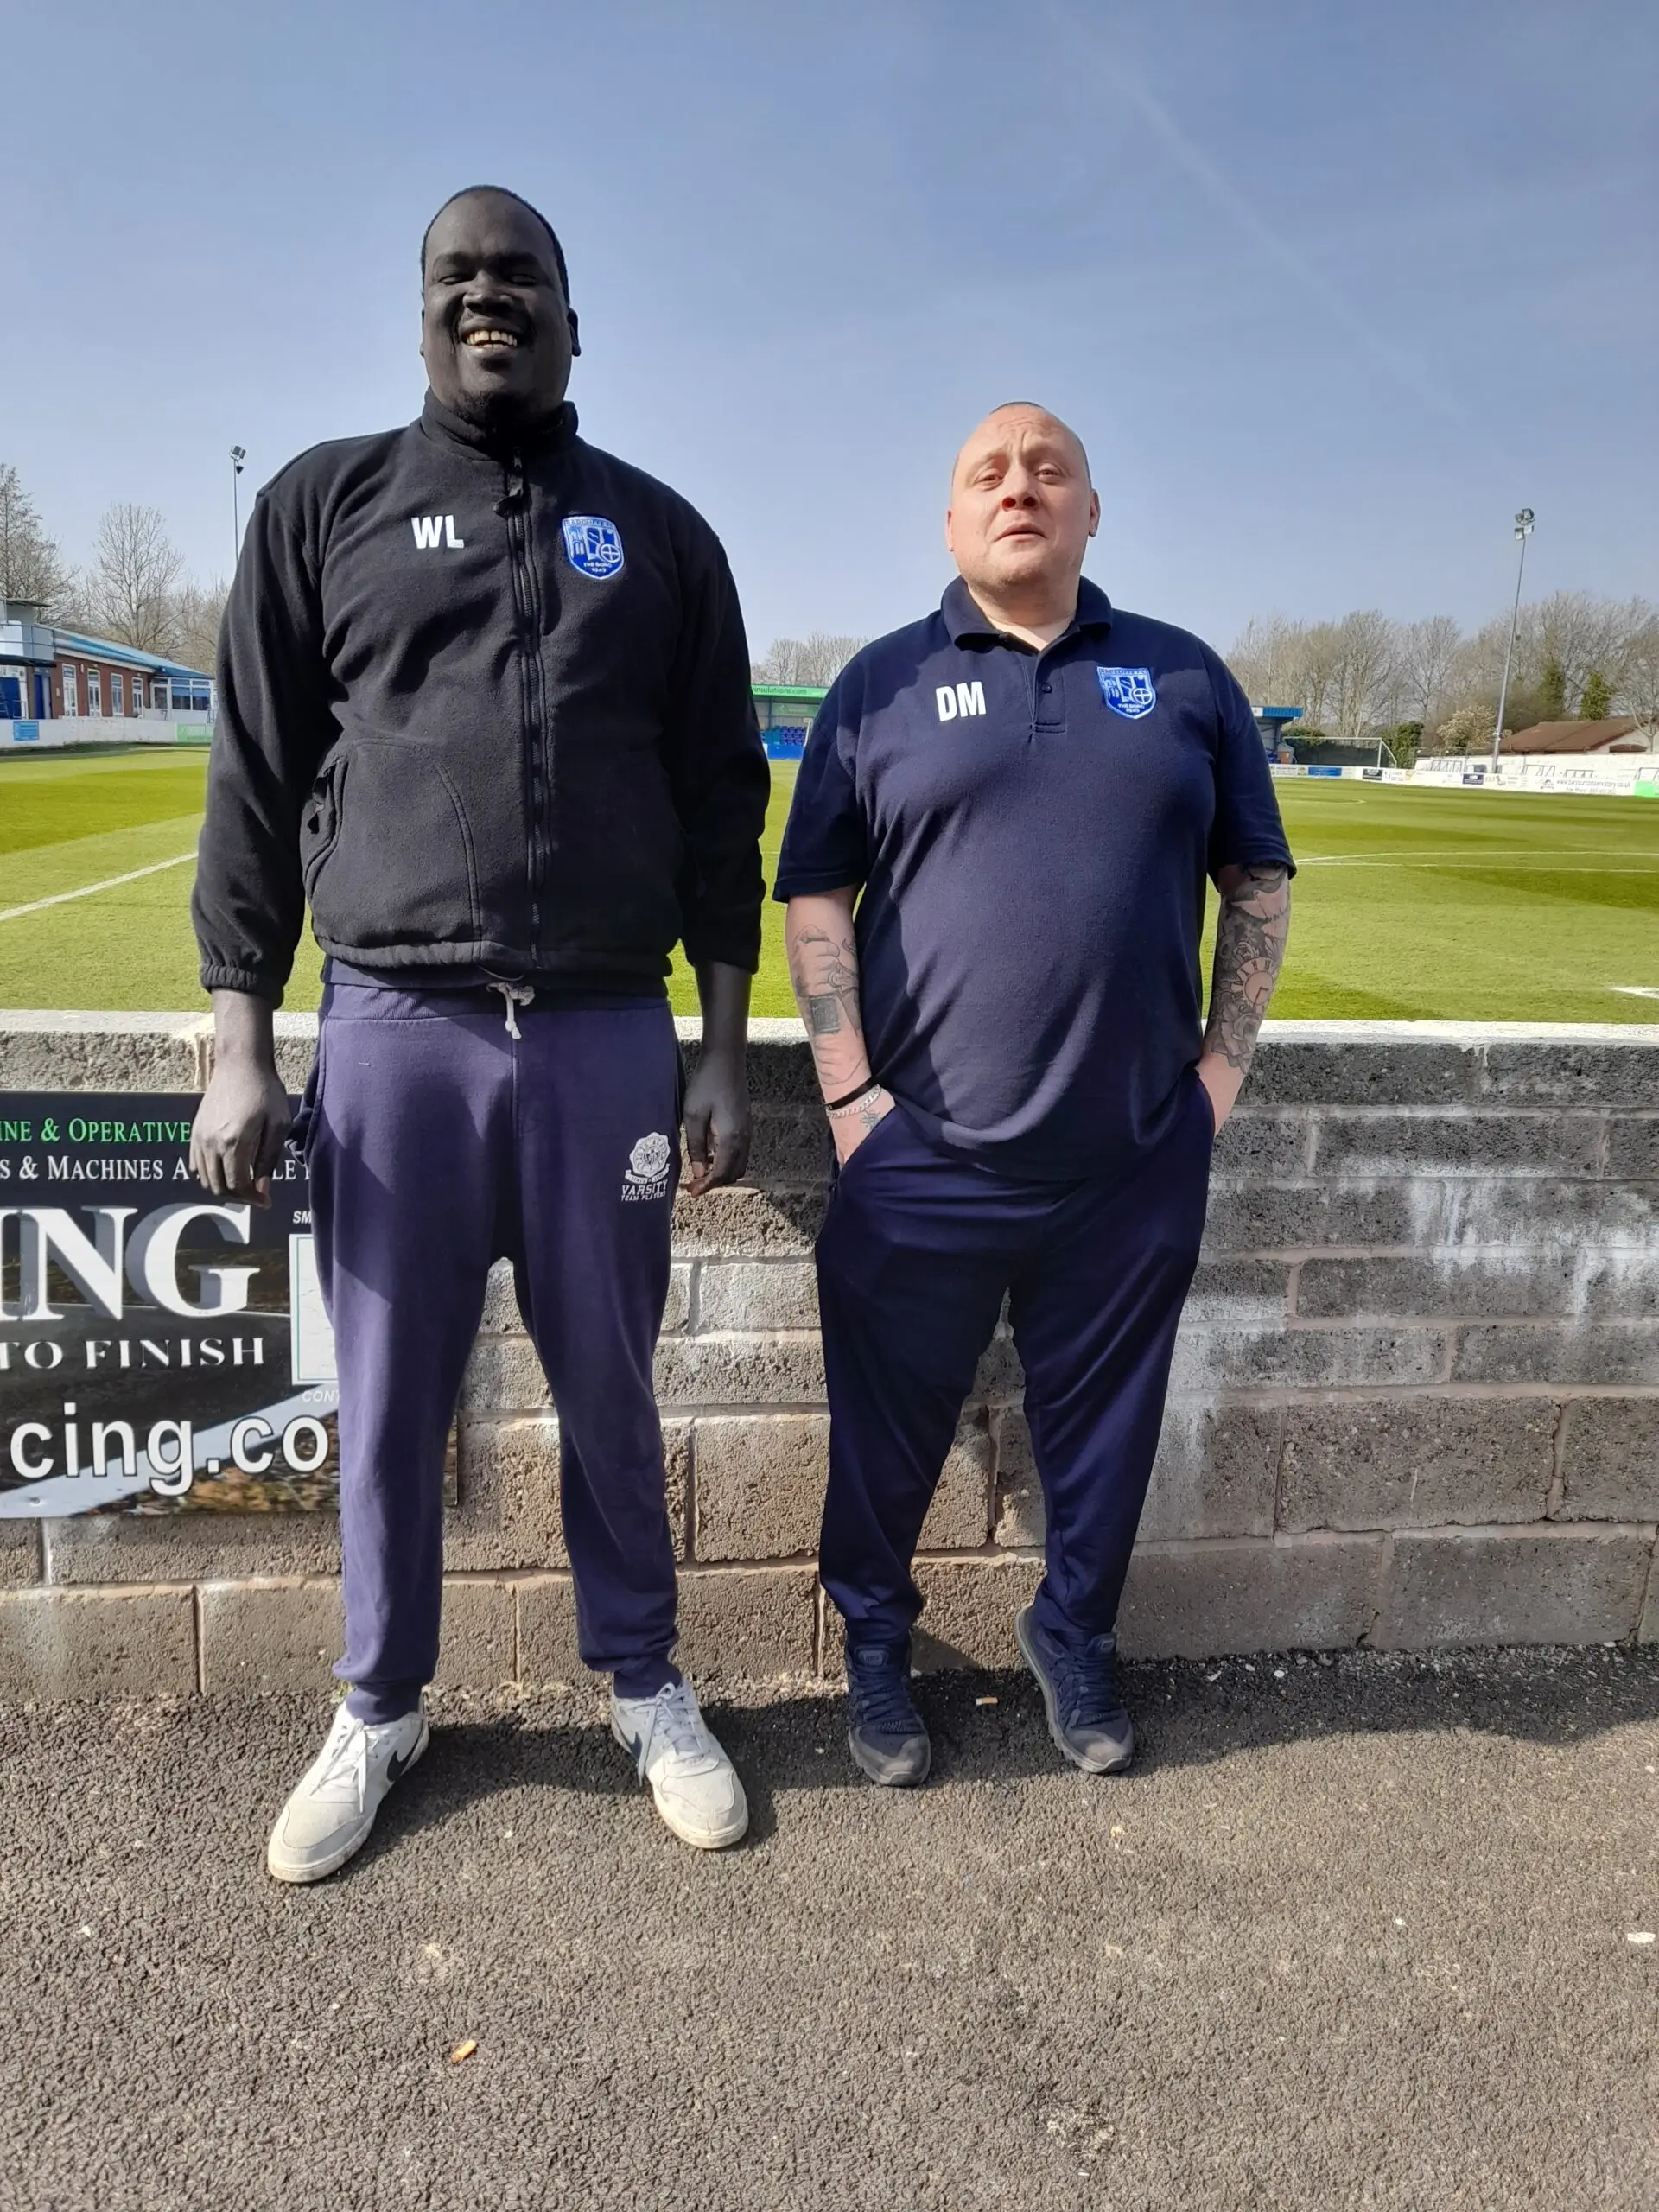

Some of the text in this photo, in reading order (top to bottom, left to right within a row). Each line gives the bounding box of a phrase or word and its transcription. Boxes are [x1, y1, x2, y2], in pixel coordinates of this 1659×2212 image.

[410, 514, 465, 549] WL
[936, 681, 987, 722] DM
[41, 1117, 60, 1142] &
[19, 1155, 39, 1180] &
[48, 1155, 164, 1180] MACHINES
[622, 1179, 668, 1195] VARSITY
[0, 1337, 264, 1369] TO FINISH
[10, 1402, 329, 1497] cing.co
